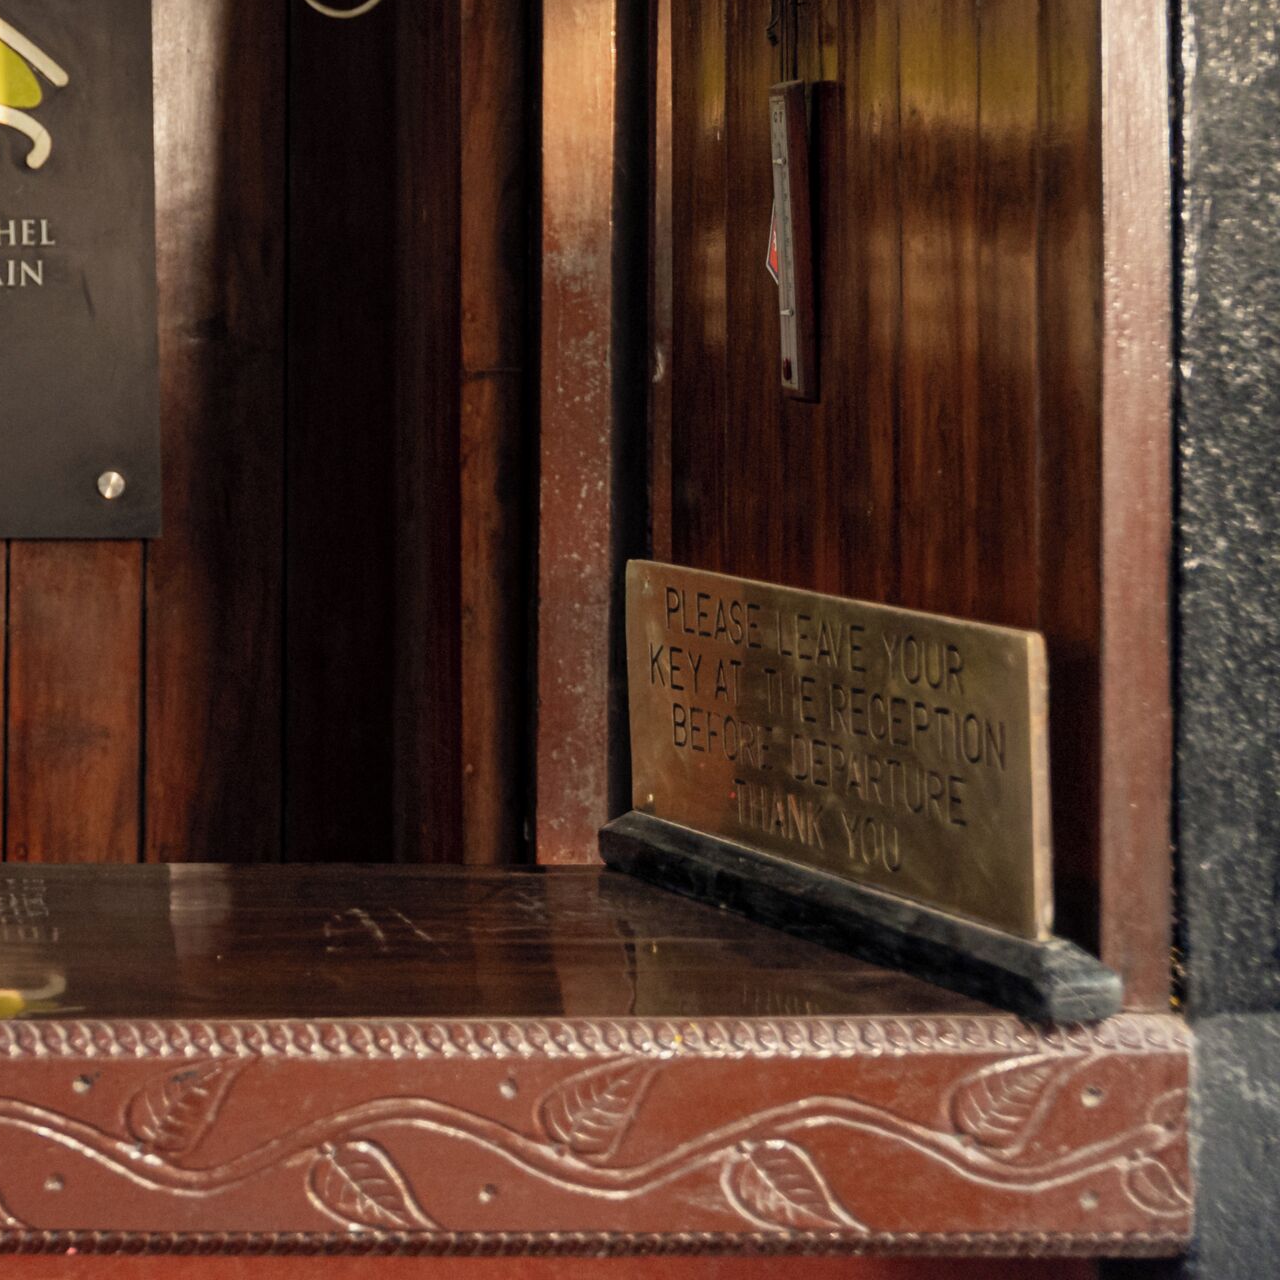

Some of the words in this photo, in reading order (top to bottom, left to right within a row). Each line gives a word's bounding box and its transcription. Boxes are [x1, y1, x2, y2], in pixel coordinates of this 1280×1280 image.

[665, 586, 762, 649] PLEASE
[776, 610, 867, 672] LEAVE
[881, 631, 965, 696] YOUR
[648, 643, 703, 694] KEY
[715, 658, 743, 704] AT
[763, 667, 817, 724] THE
[828, 682, 1006, 771] RECEPTION
[671, 702, 774, 771] BEFORE
[791, 733, 967, 827] DEPARTURE
[733, 778, 825, 850] THANK
[841, 807, 901, 872] YOU
